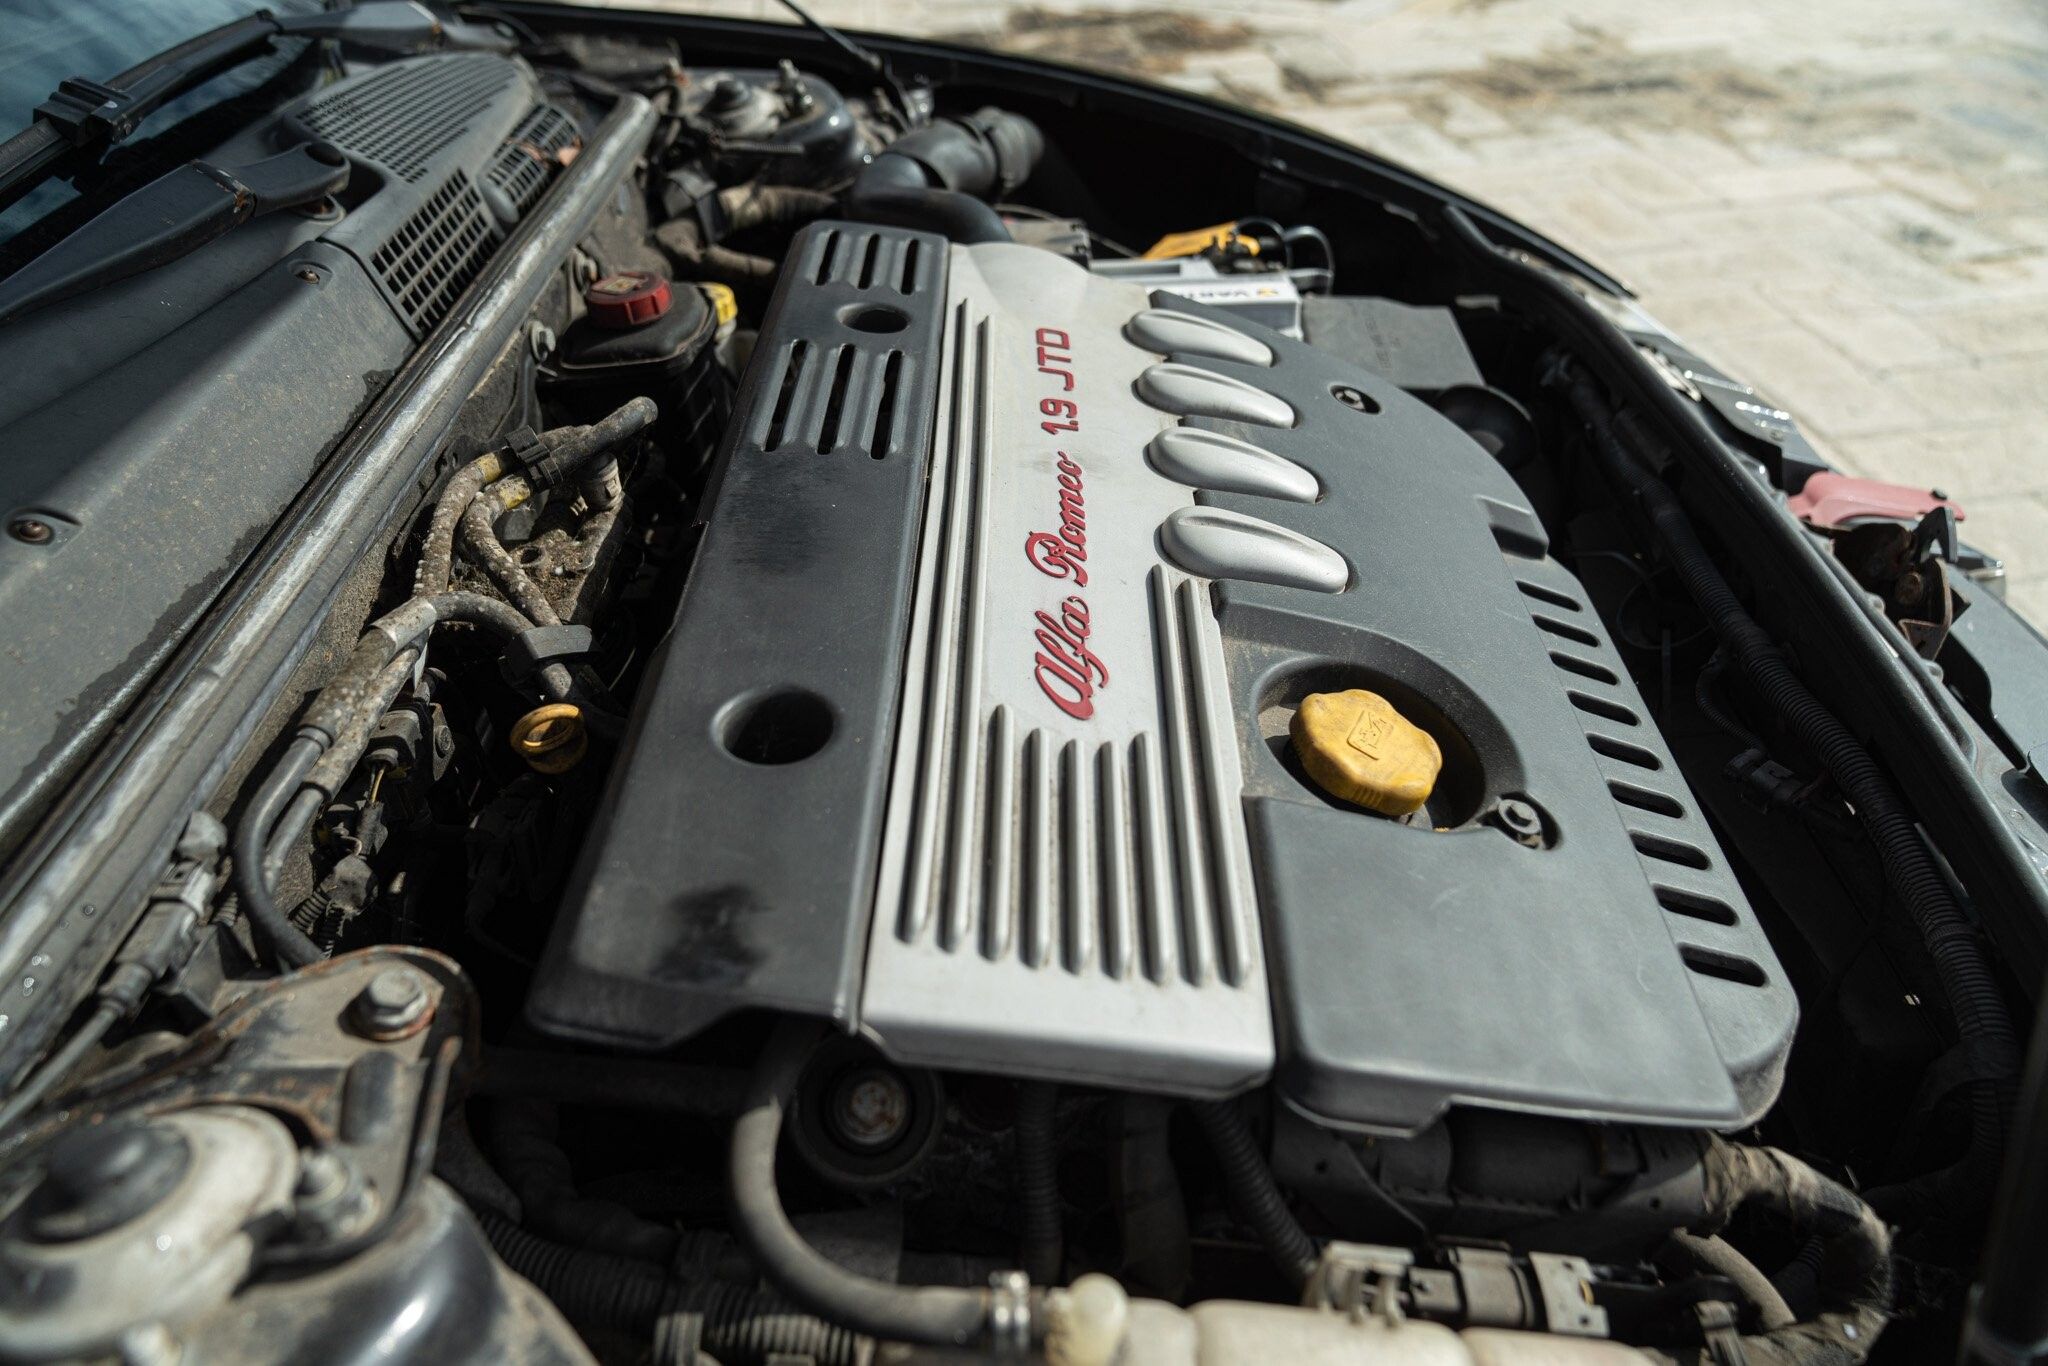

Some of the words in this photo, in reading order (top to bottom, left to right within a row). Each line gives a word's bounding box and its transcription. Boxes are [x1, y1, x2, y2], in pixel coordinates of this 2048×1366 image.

[1035, 327, 1074, 391] JTD
[1040, 398, 1079, 435] 1.9
[1025, 450, 1088, 587] Romeo
[1034, 596, 1109, 720] Alfa
